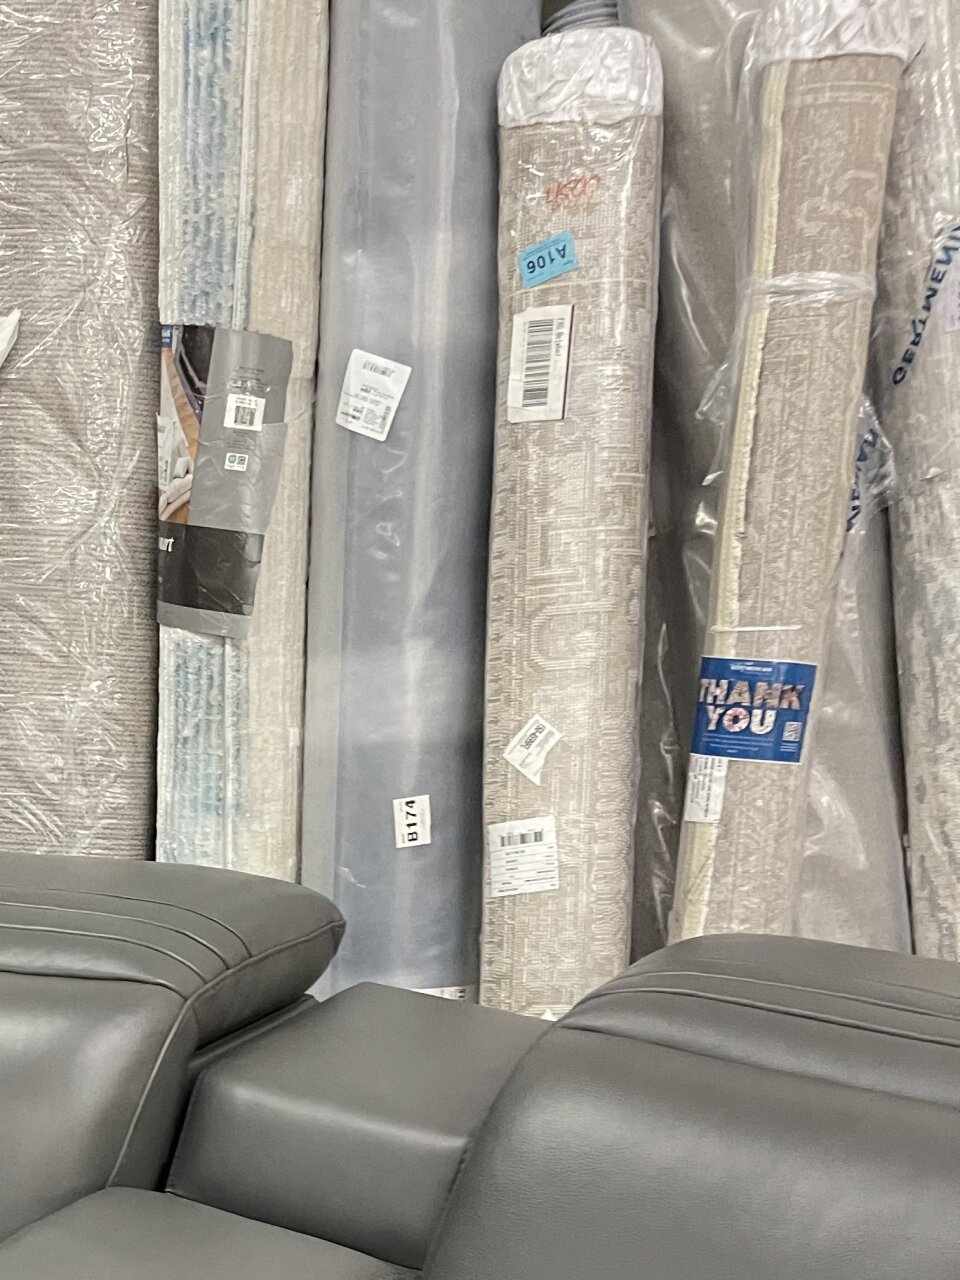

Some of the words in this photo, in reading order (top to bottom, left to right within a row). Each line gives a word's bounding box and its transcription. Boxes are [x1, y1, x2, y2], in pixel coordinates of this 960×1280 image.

[526, 244, 567, 274] A106
[699, 678, 806, 710] THANK
[705, 705, 777, 735] YOU
[404, 800, 418, 842] B174
